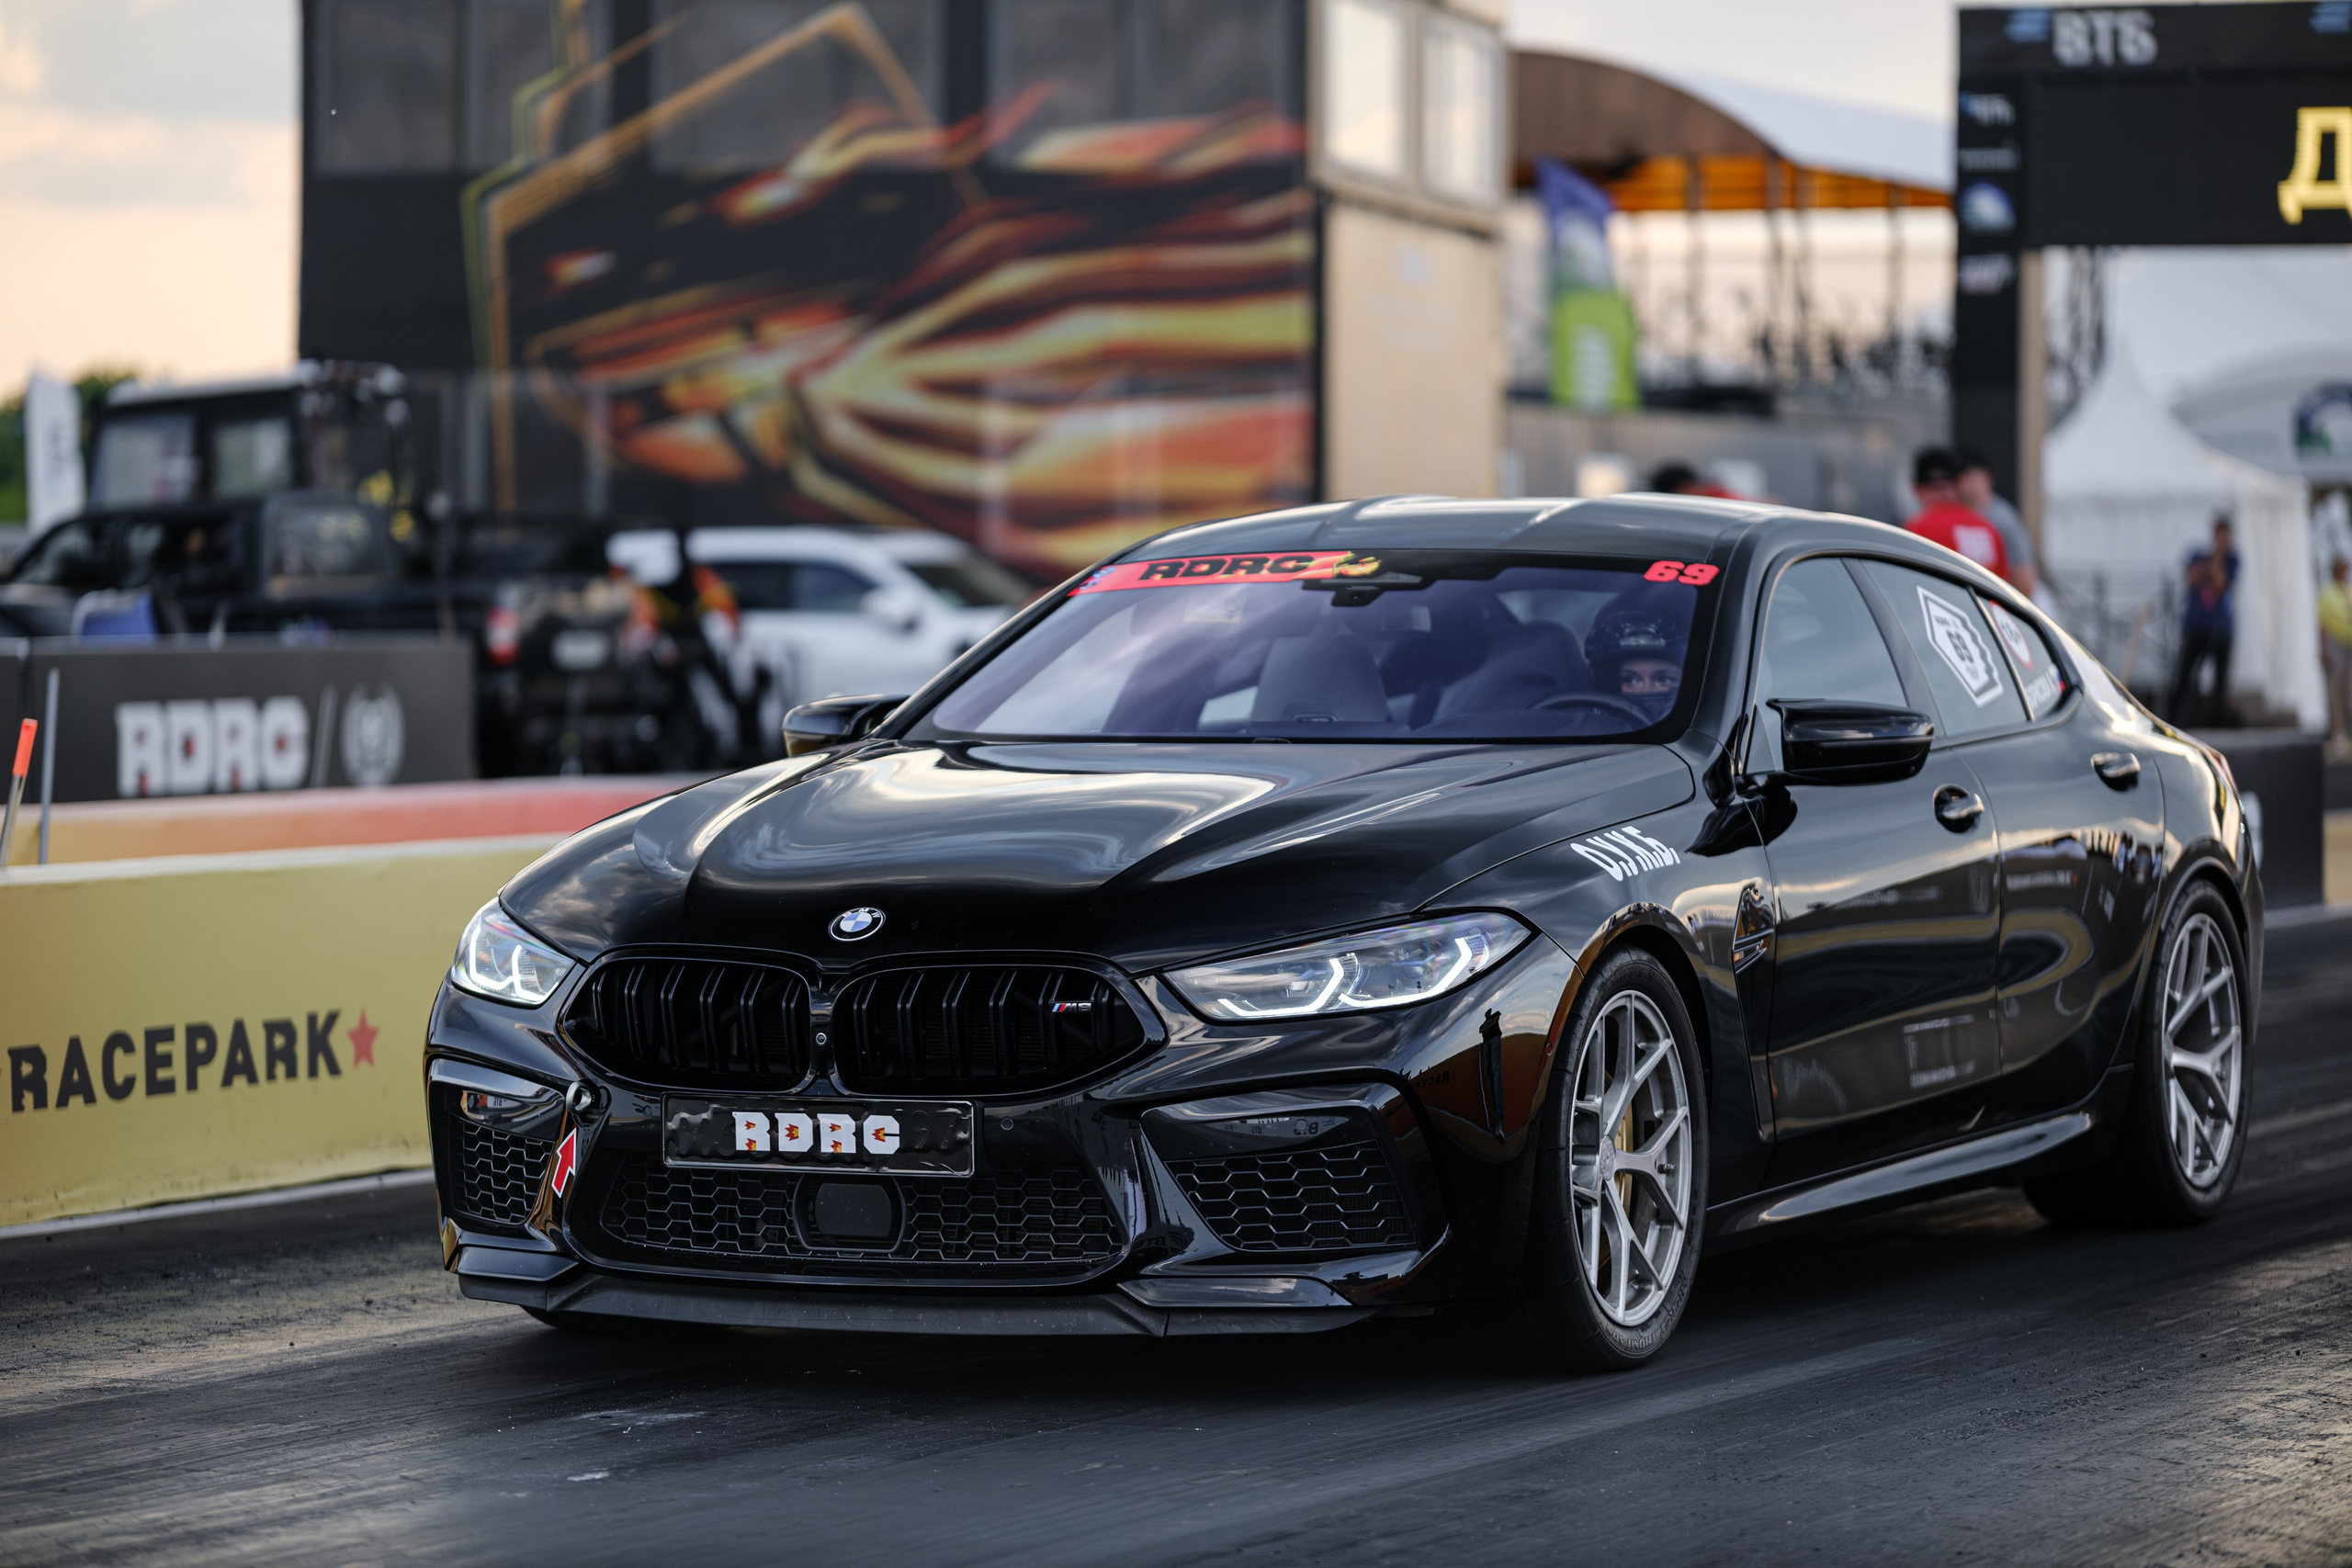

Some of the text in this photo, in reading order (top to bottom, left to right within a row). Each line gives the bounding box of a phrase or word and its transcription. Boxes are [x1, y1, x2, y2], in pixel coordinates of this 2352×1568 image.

[2277, 106, 2352, 224] Д
[1139, 553, 1315, 581] RDRC
[1643, 559, 1721, 587] 69
[1945, 630, 1974, 663] 69
[1062, 1002, 1092, 1012] M8
[7, 1008, 342, 1113] RACEPARK
[731, 1111, 900, 1155] RDRC
